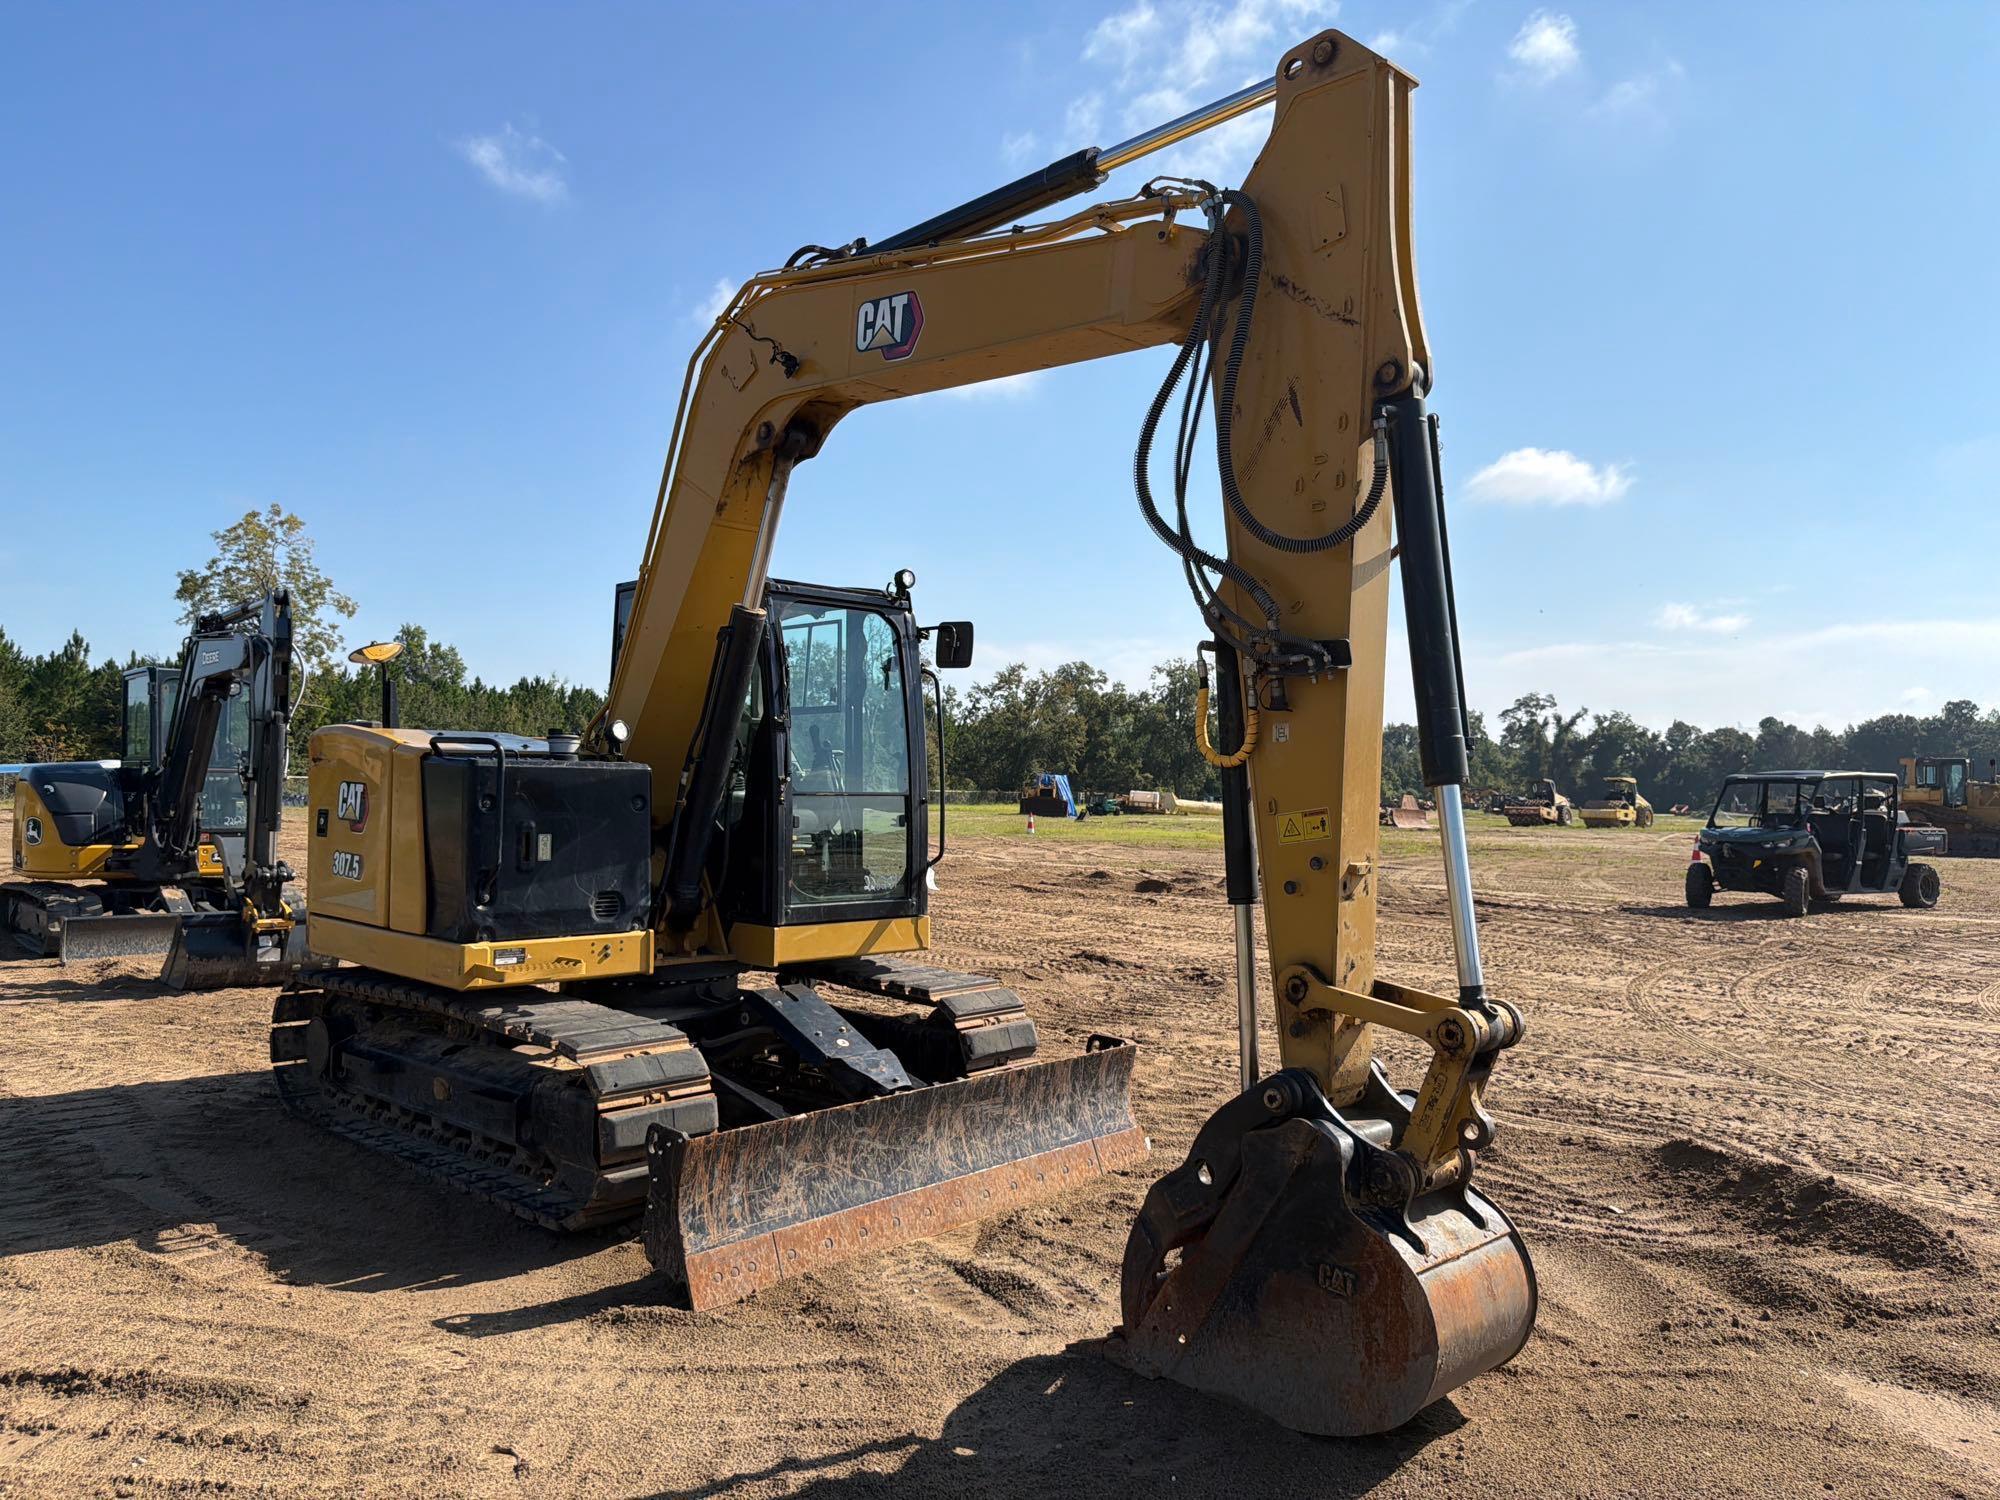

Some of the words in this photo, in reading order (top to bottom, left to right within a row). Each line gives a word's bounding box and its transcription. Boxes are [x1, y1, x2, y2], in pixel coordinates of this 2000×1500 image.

[857, 293, 909, 351] CAT
[202, 650, 219, 665] DEERE
[338, 781, 364, 819] CAT
[332, 851, 361, 880] 307.5
[1318, 1263, 1356, 1298] CAT
